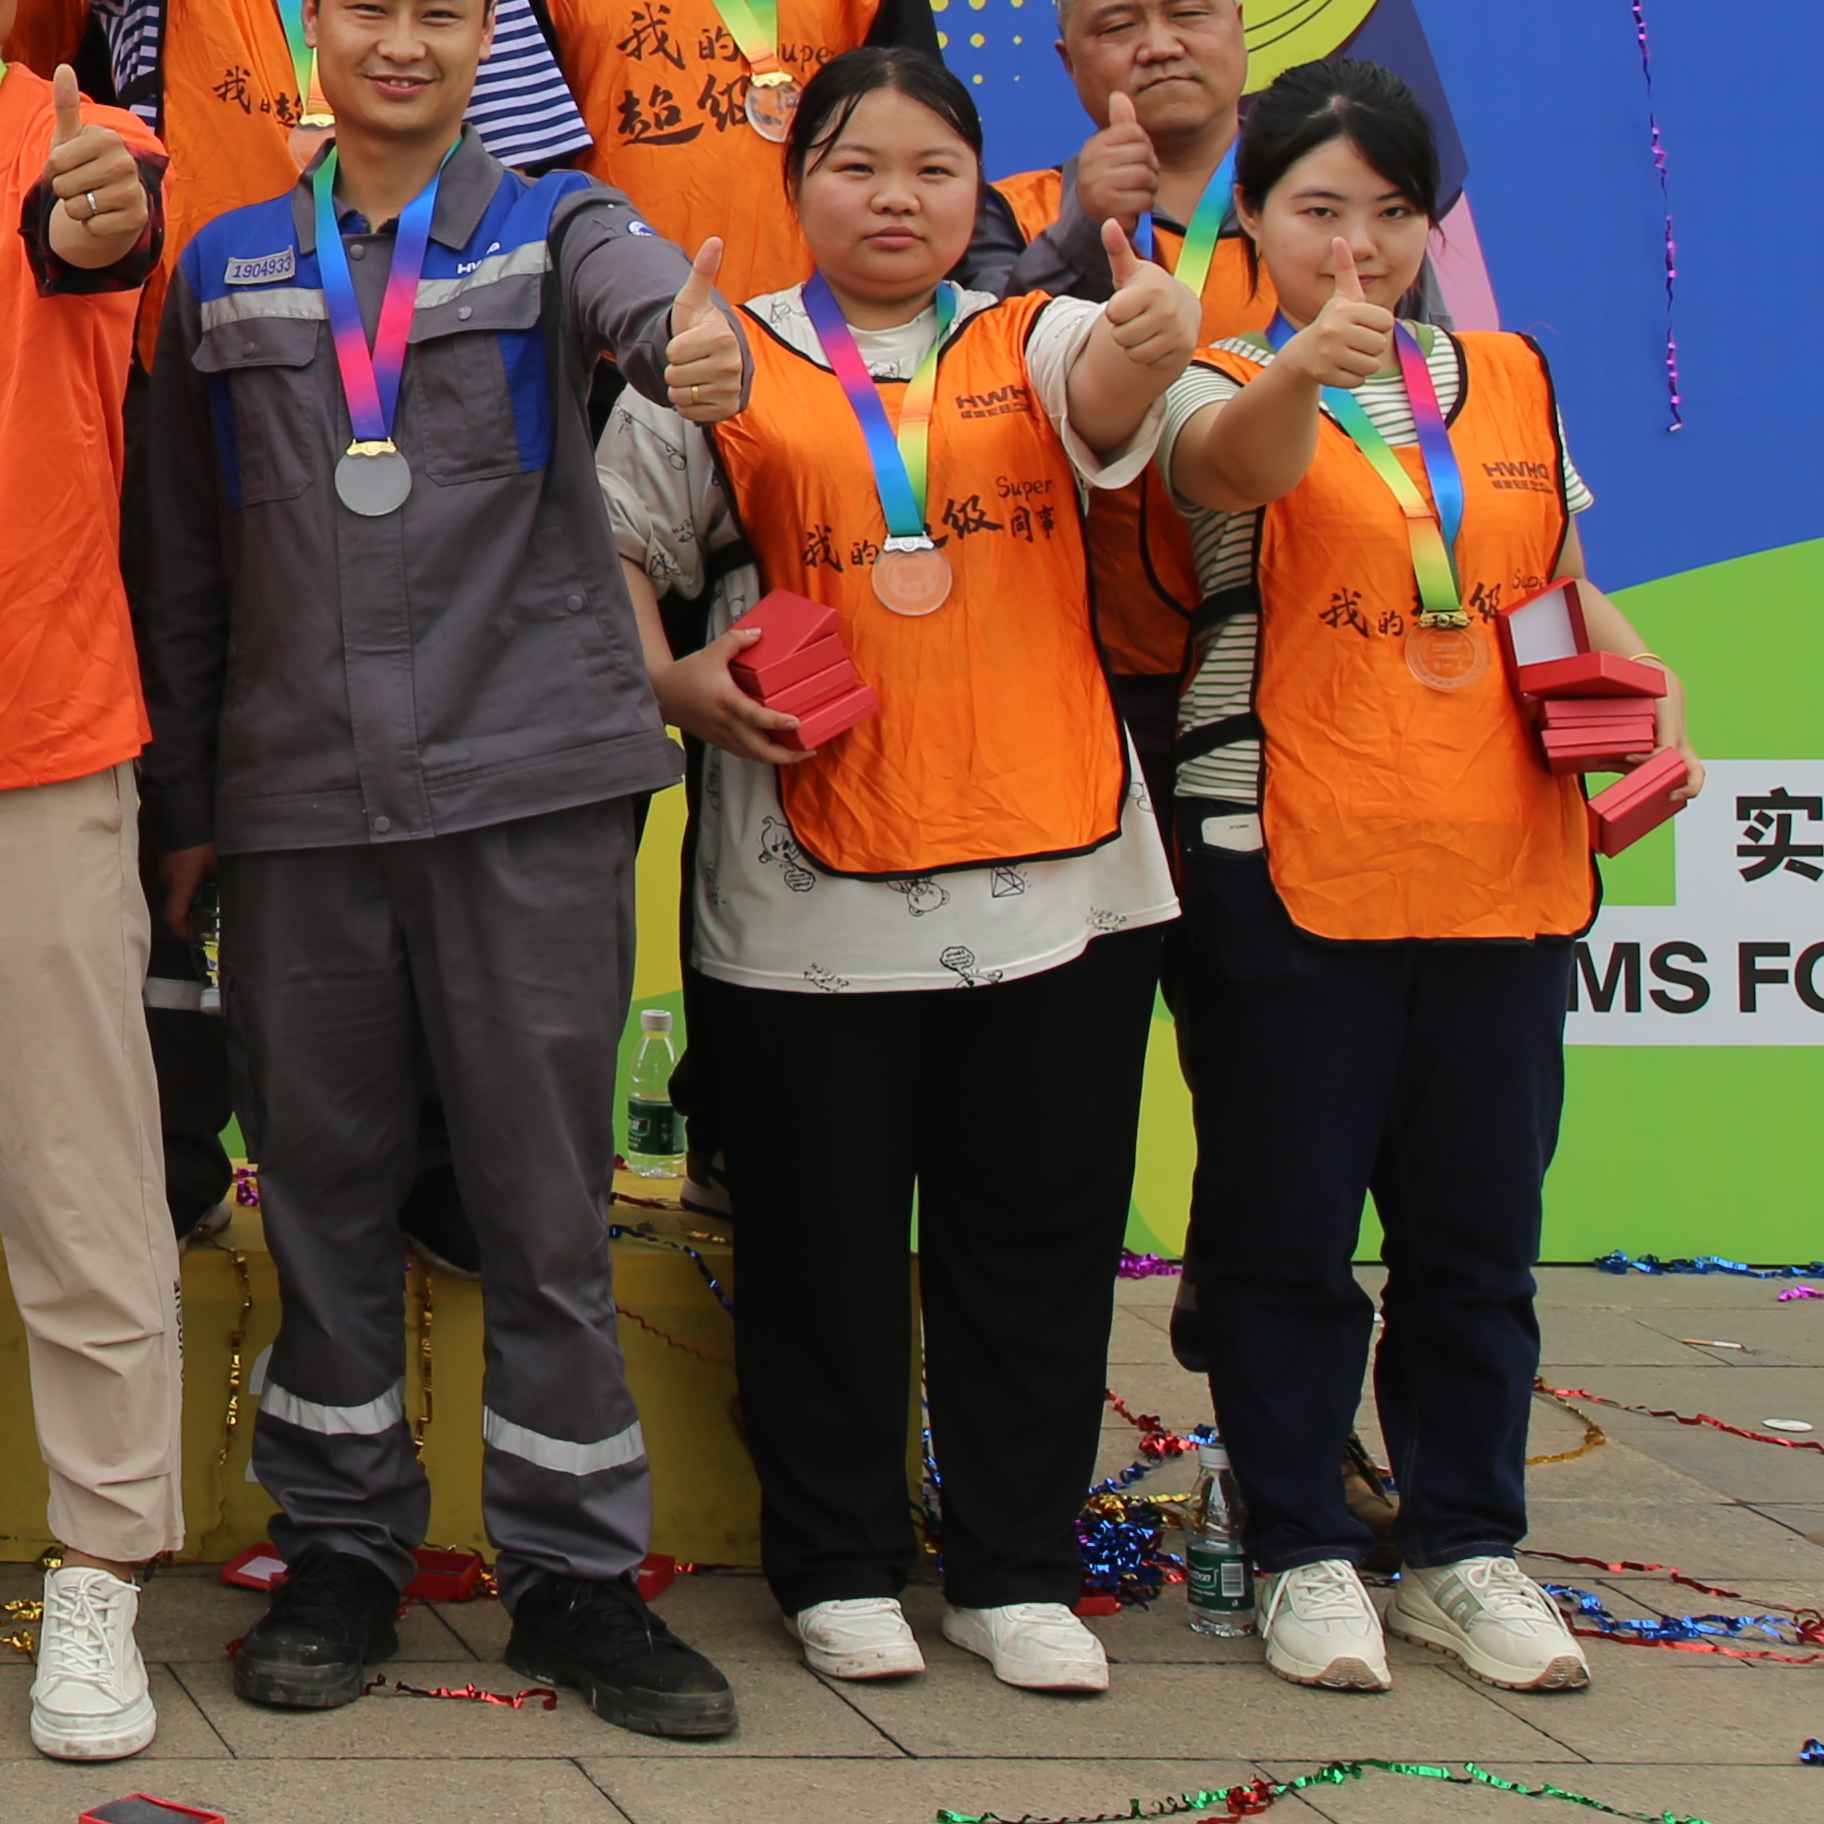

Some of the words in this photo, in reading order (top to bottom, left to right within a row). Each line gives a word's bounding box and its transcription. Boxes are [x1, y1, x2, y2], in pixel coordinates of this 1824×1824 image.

[232, 255, 293, 280] 1904933
[996, 475, 1054, 506] Super
[1735, 786, 1824, 883] 实
